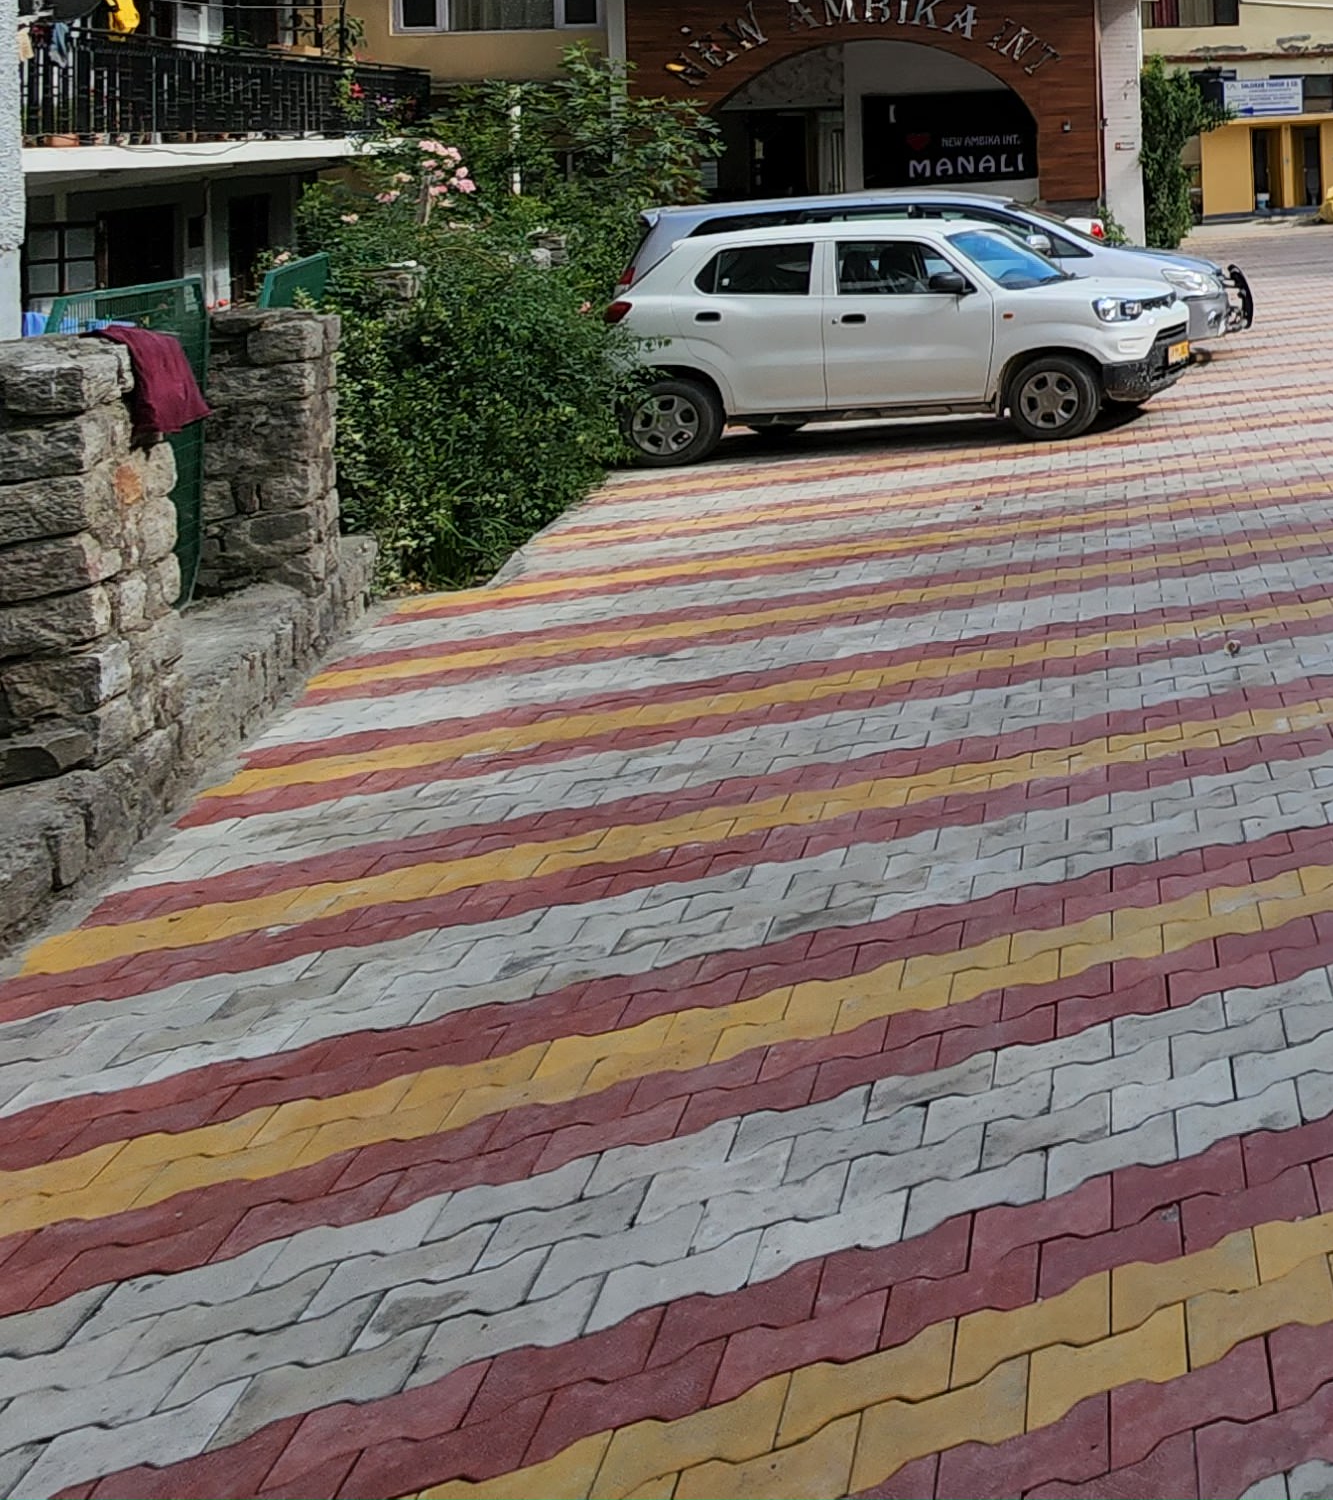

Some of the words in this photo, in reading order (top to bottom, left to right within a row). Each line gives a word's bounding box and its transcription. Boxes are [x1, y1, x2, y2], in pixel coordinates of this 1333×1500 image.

[664, 0, 769, 88] NEW
[986, 17, 1062, 76] INT
[941, 136, 963, 147] NEW
[964, 135, 1000, 147] AMBIKA
[909, 153, 1025, 179] MANALI
